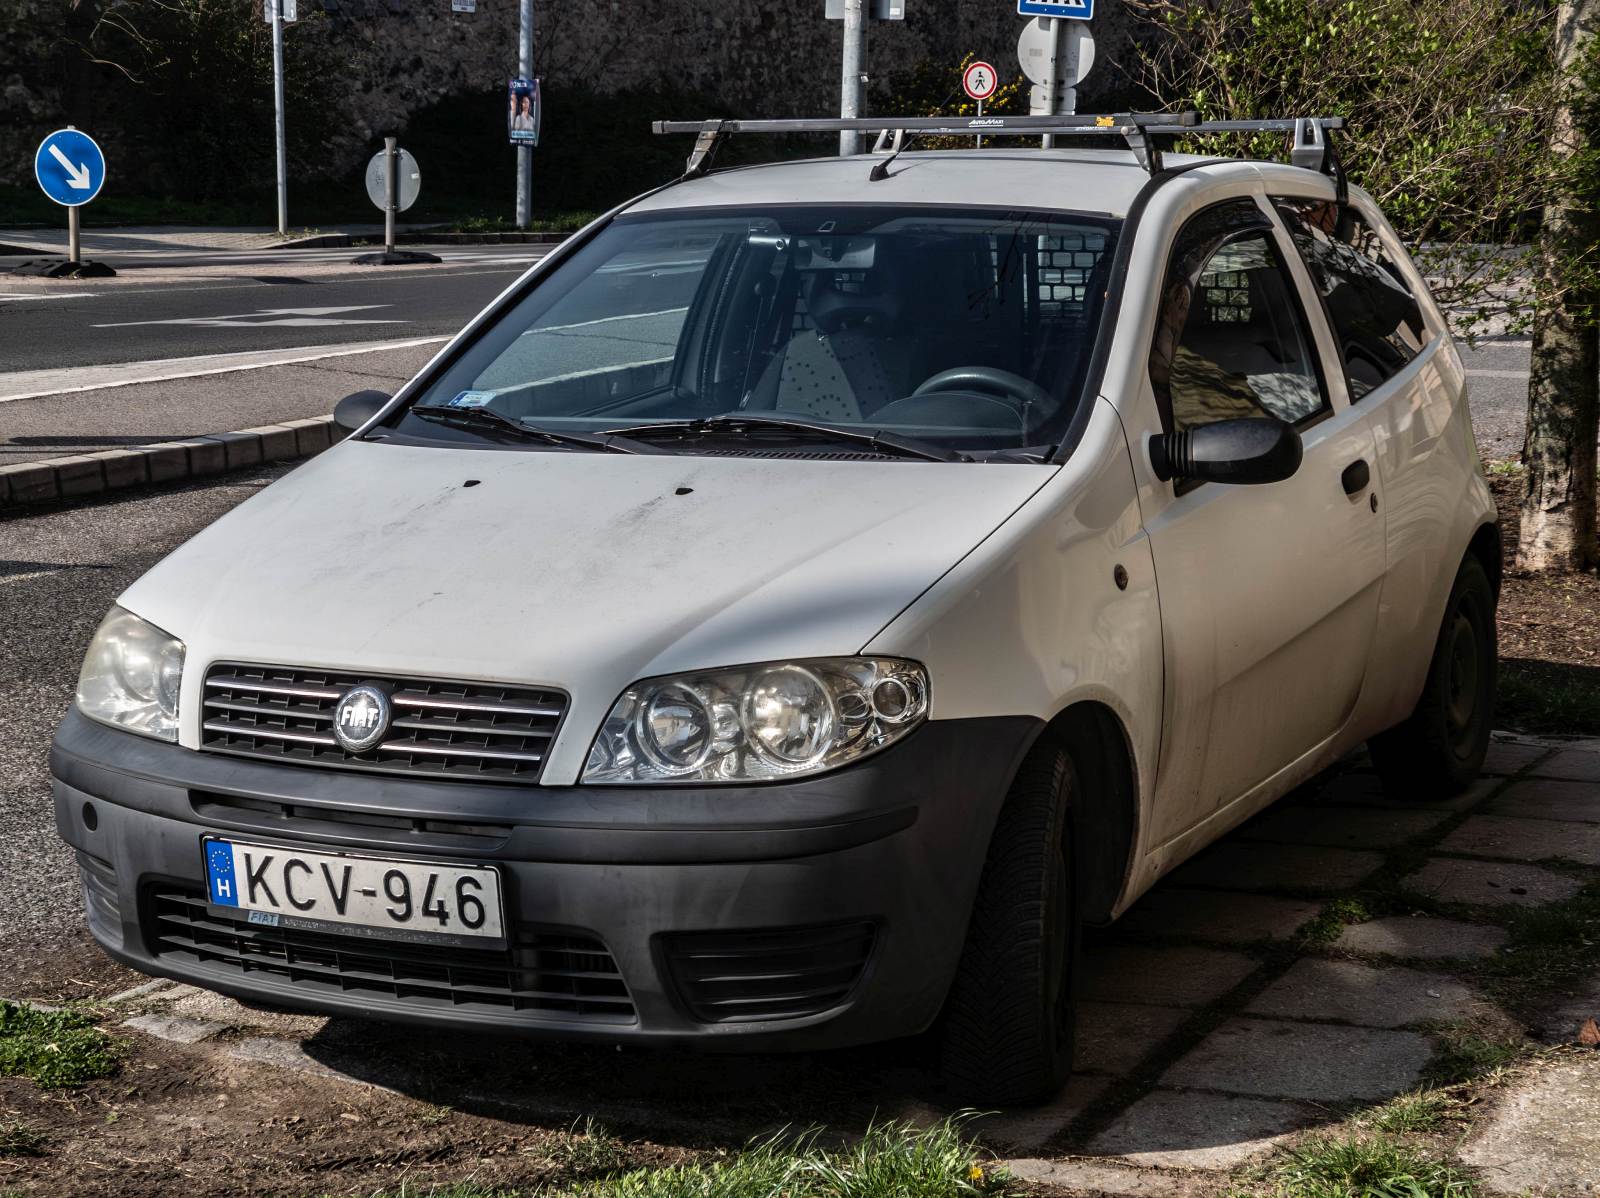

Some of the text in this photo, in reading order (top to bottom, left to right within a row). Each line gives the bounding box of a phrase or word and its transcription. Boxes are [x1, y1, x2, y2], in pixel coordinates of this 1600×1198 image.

[341, 705, 378, 728] FIAT
[216, 878, 231, 898] H
[244, 852, 485, 930] KCV-946
[249, 912, 278, 925] FIAT
